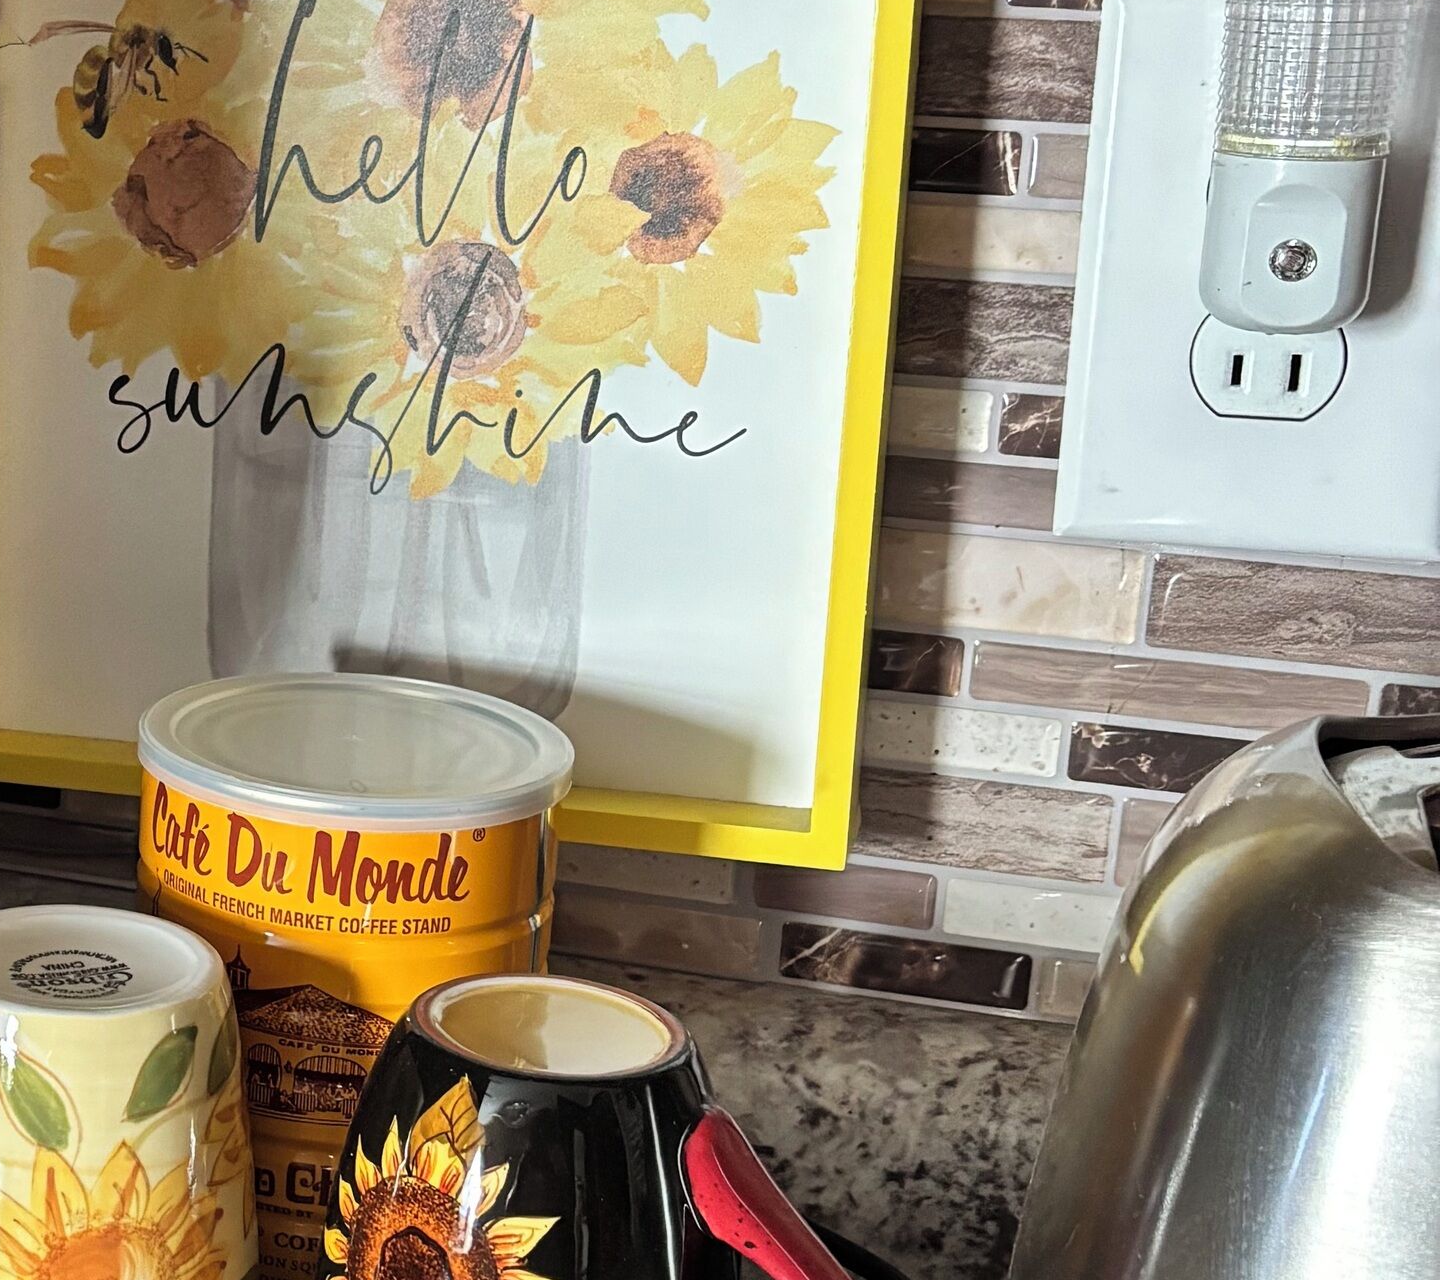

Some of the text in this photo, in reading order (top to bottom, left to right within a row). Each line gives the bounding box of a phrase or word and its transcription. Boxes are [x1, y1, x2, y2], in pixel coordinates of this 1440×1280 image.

[107, 250, 747, 495] sunshine
[152, 780, 470, 907] Café Du Monde
[163, 868, 451, 935] ORIGINAL FRENCH MARKET COFFEE STAND
[41, 961, 85, 971] CHINA
[321, 1045, 340, 1054] DU
[346, 1047, 381, 1057] MON
